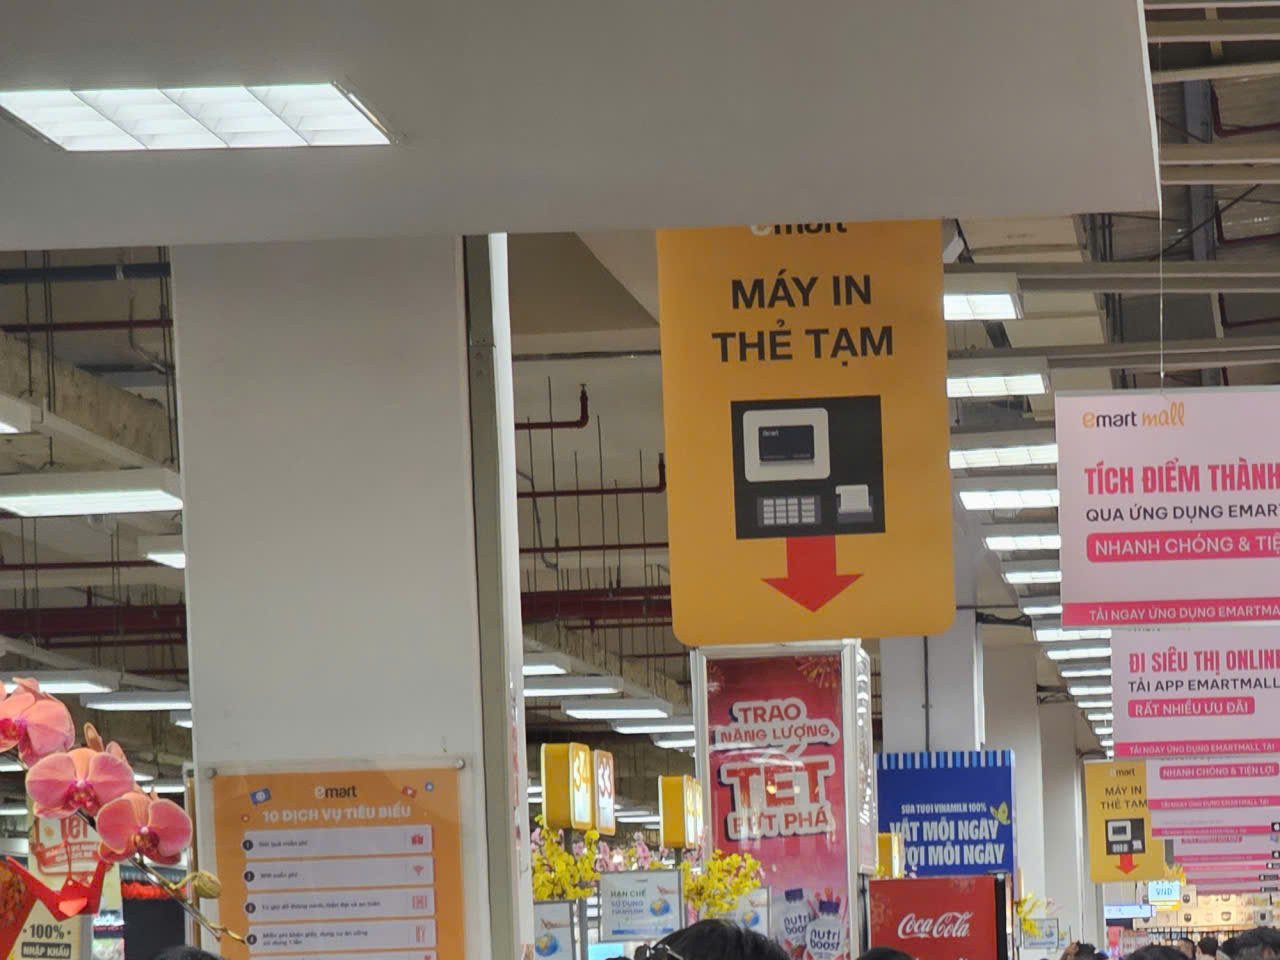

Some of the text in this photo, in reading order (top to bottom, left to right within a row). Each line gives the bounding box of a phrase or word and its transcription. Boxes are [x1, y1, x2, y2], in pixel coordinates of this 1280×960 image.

[731, 268, 872, 310] MÁY IN
[711, 318, 894, 367] THẺ TẠM
[1082, 401, 1185, 429] emart mall
[1084, 460, 1135, 496] TÍCH
[1141, 456, 1201, 494] ĐIỂM
[1086, 507, 1125, 522] QUA
[1129, 503, 1168, 521] ỨNG
[1173, 505, 1224, 524] DỤNG
[1095, 538, 1160, 556] NHANH
[1164, 533, 1234, 555] CHÓNG
[1238, 537, 1250, 551] &
[1111, 608, 1145, 621] NGAY
[1148, 605, 1177, 620] ỨNG
[1179, 606, 1216, 622] DỤNG
[1129, 652, 1145, 673] ĐI
[1152, 646, 1188, 673] SIÊU
[1194, 649, 1220, 676] THỊ
[1128, 677, 1280, 693] TẢI APP EMARTMALL
[738, 703, 802, 725] TRAO
[1135, 699, 1248, 716] RẤT NHIỀU ƯU ĐÃI
[720, 728, 768, 743] NĂNG
[726, 744, 830, 808] TẾT
[1162, 767, 1197, 778] NHANH
[313, 785, 358, 800] emart
[1104, 785, 1142, 797] MÁY IN
[263, 810, 279, 823] 10
[282, 807, 319, 823] DỊCH
[322, 807, 342, 823] VỤ
[934, 803, 968, 814] VINAMILK
[968, 802, 987, 813] 100%
[784, 806, 829, 831] PHÁ
[30, 924, 65, 939] 100%
[811, 928, 841, 940] nutri
[810, 938, 841, 951] boost
